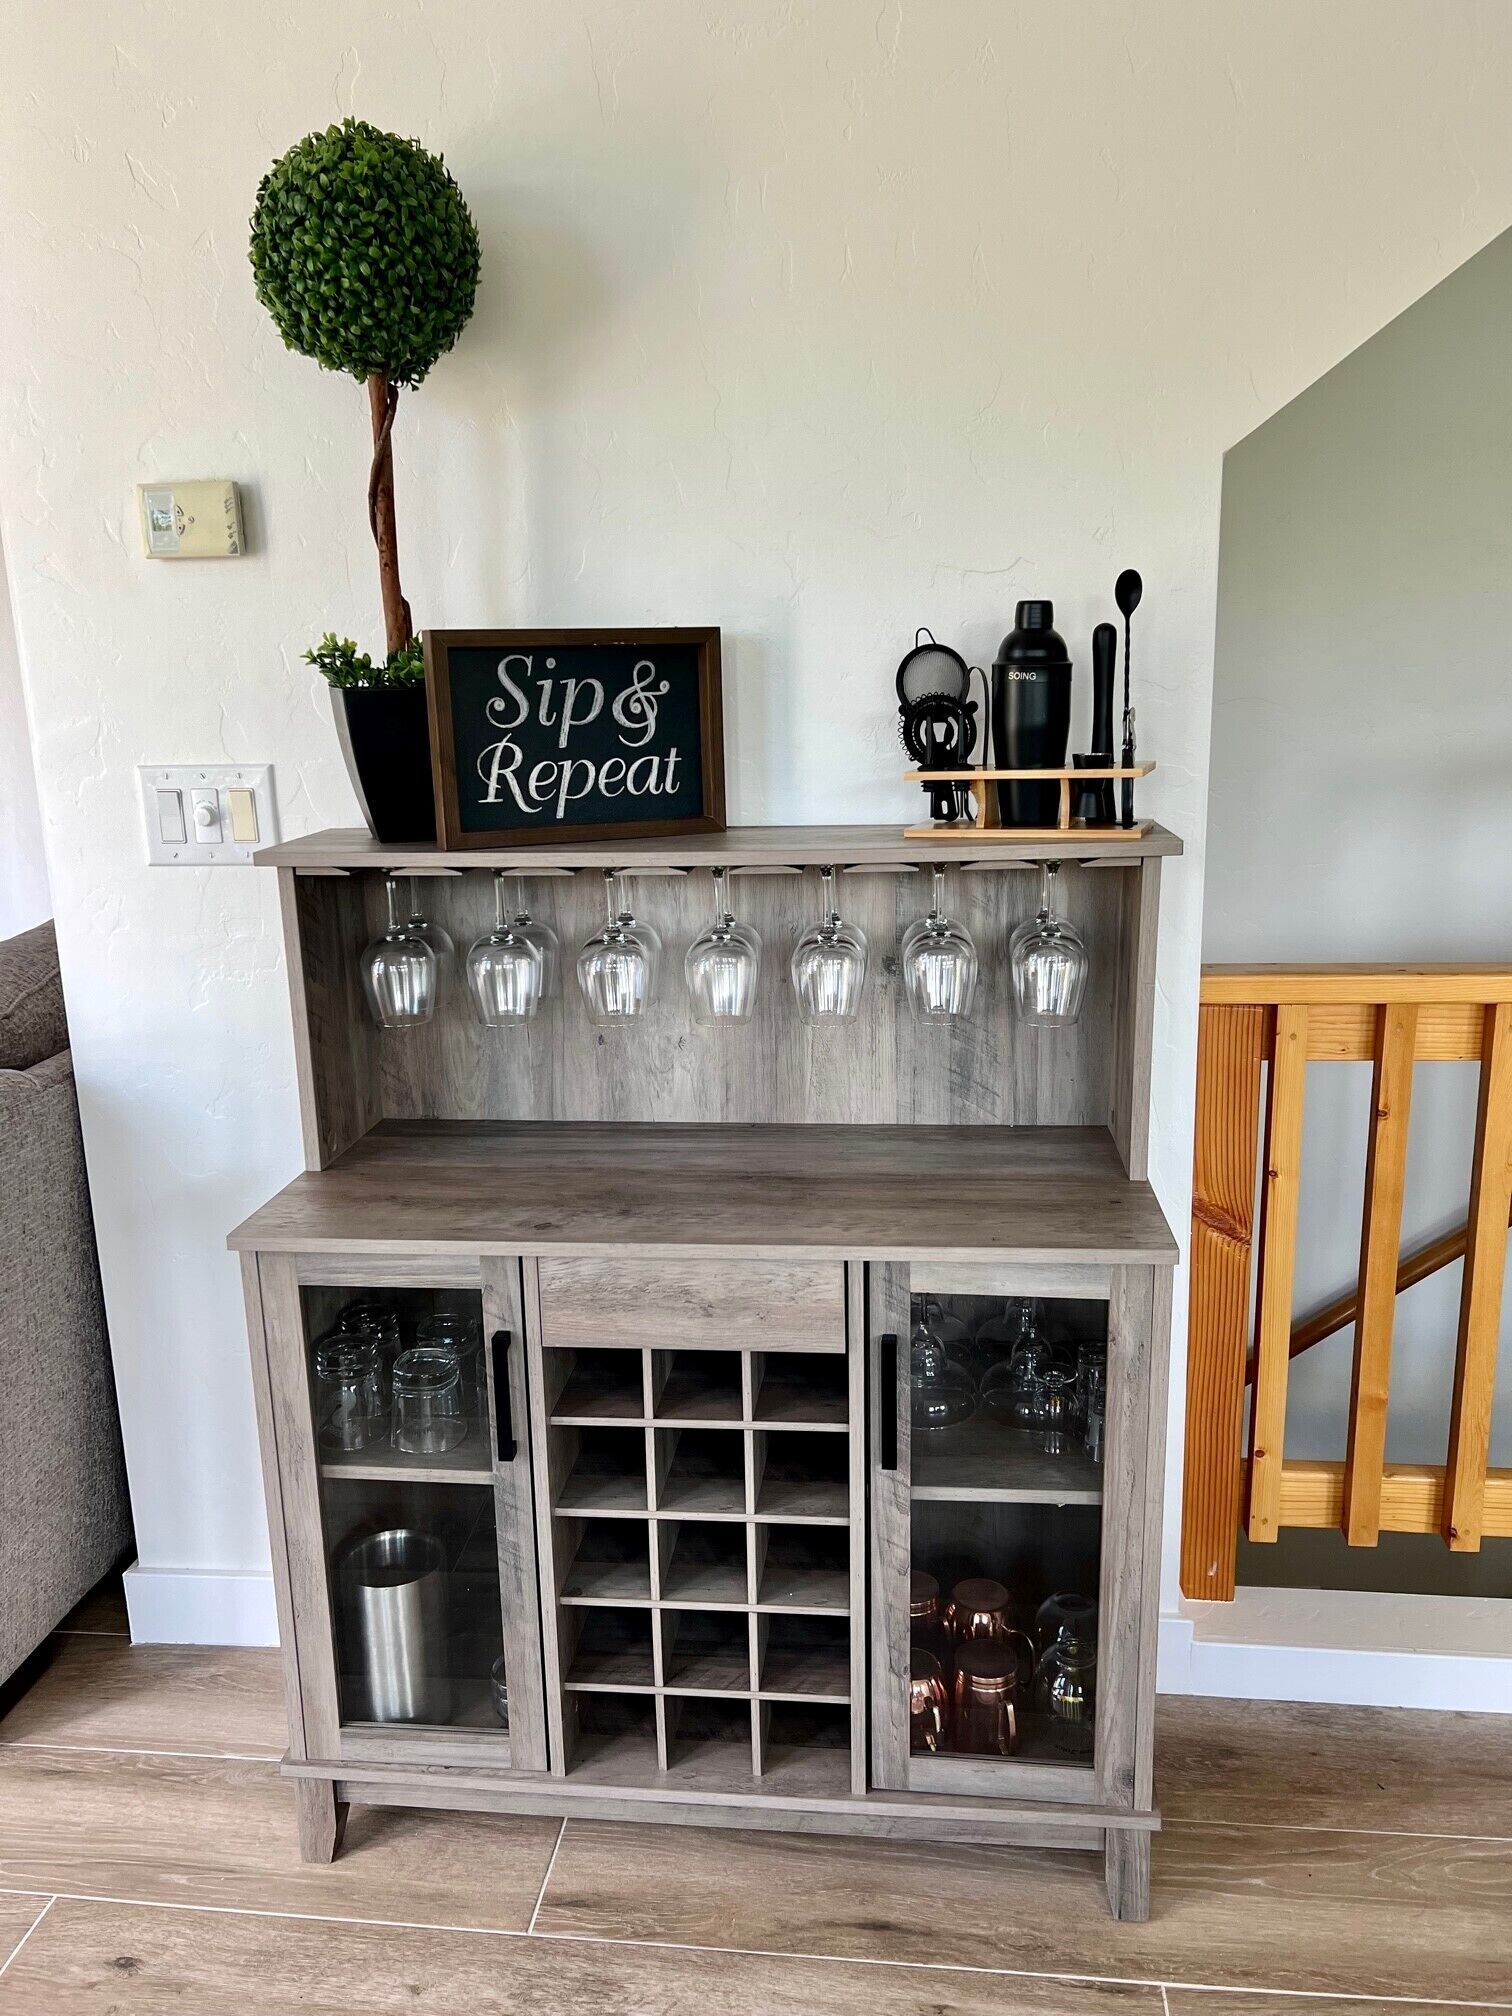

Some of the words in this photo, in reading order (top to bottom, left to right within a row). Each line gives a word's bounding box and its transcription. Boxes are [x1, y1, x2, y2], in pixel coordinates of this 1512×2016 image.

[485, 655, 605, 748] Sip
[612, 660, 670, 747] &
[1008, 671, 1037, 681] SOING
[477, 732, 682, 819] Repeat
